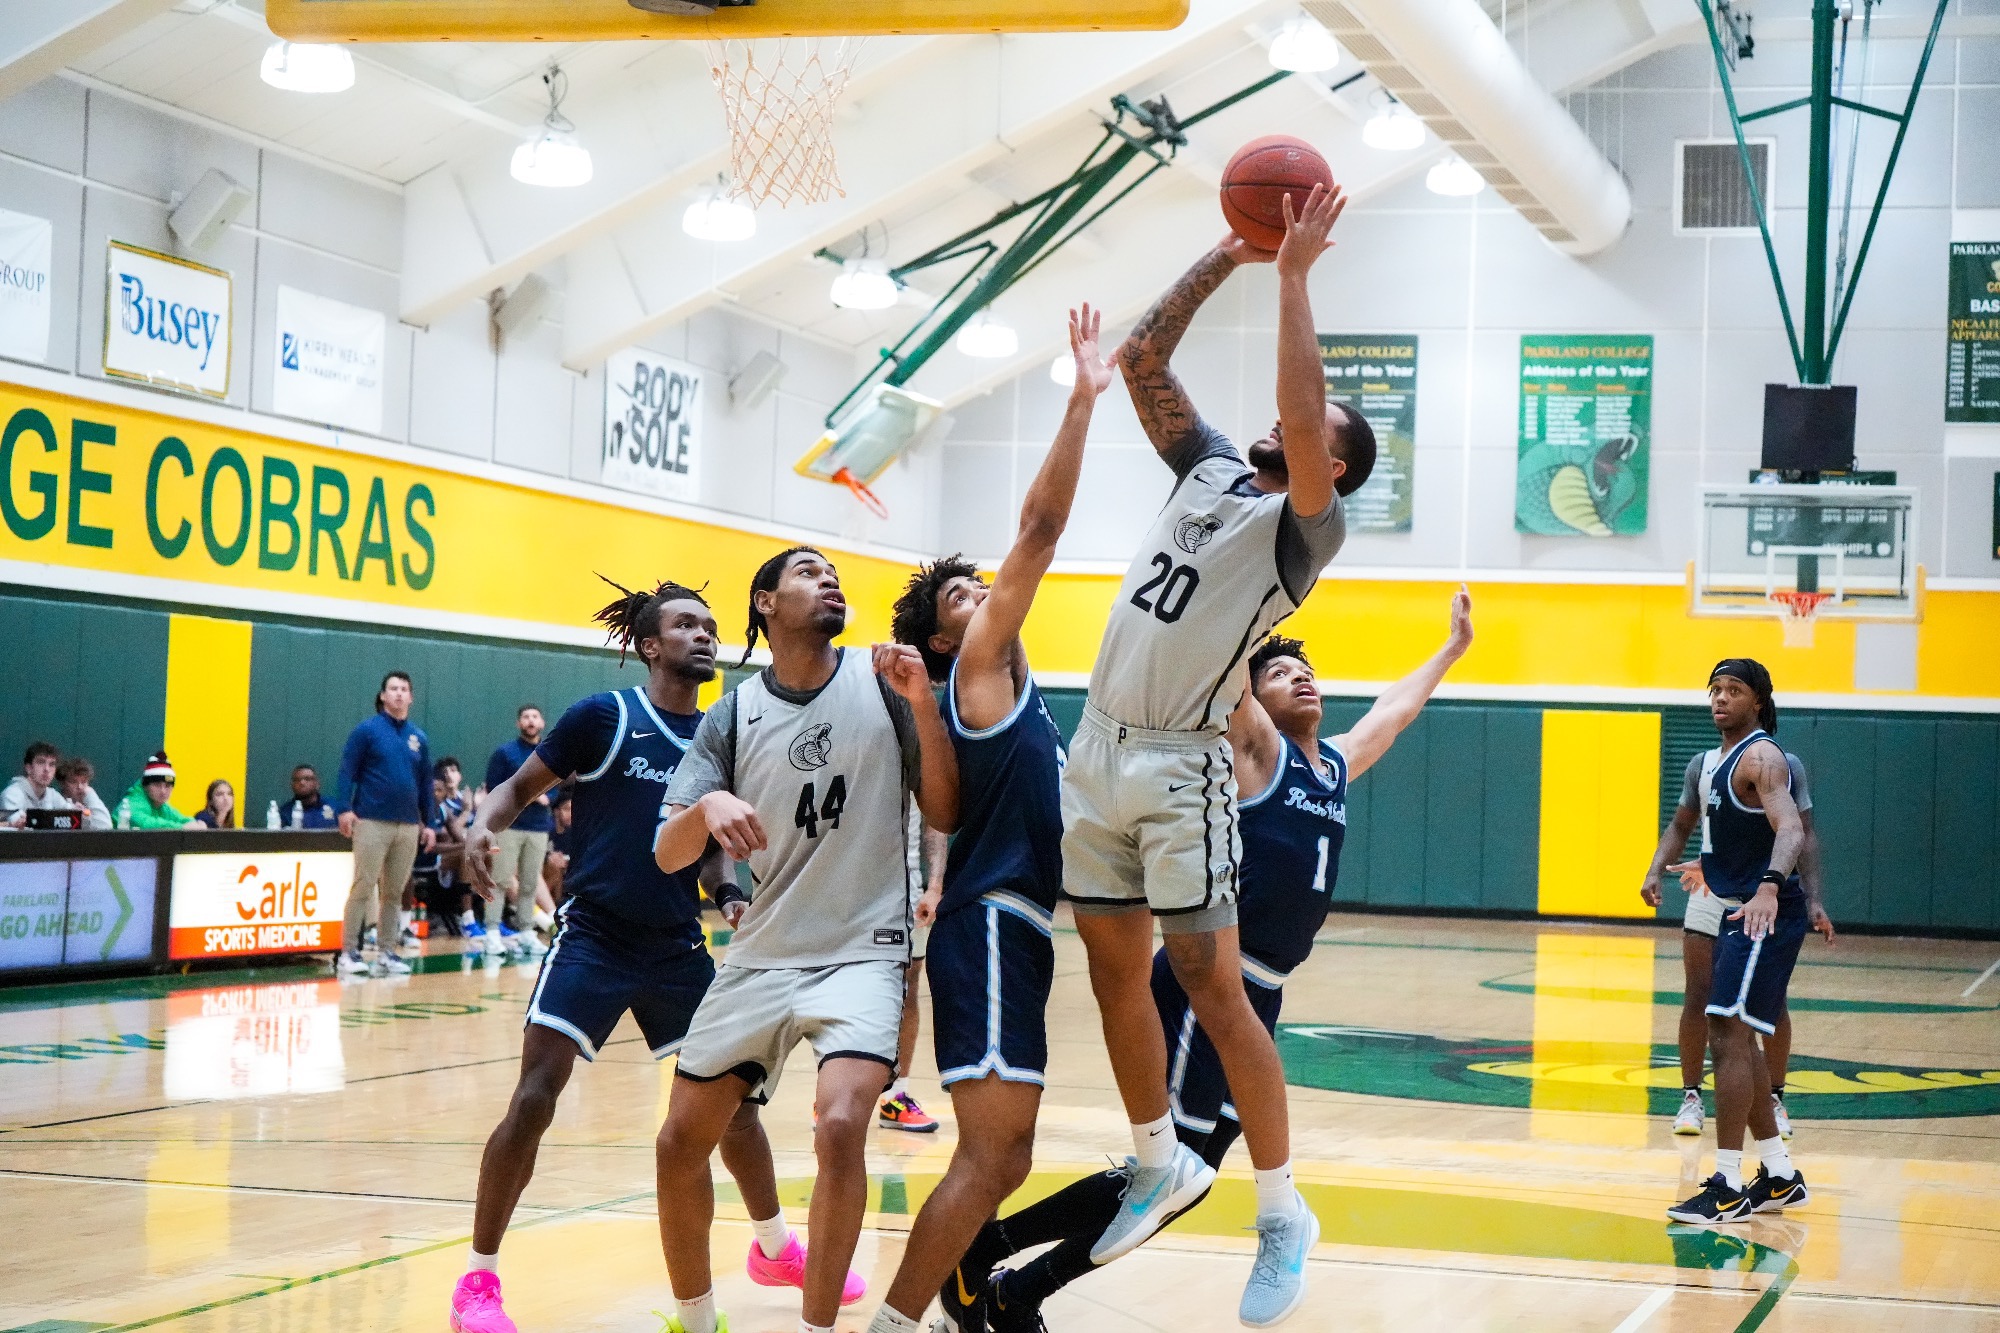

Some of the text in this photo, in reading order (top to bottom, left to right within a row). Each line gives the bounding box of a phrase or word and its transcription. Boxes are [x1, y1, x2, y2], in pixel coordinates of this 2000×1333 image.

[0, 259, 45, 292] ROUP
[119, 273, 219, 371] Busey
[629, 404, 691, 475] SOLE
[0, 408, 436, 591] GE COBRAS
[1130, 551, 1200, 624] 20
[1118, 727, 1127, 744] P
[794, 774, 847, 838] 44
[236, 861, 318, 921] Carle
[1312, 835, 1330, 892] 1
[0, 911, 103, 940] GO AHEAD
[204, 923, 321, 953] SPORTS MEDICINE
